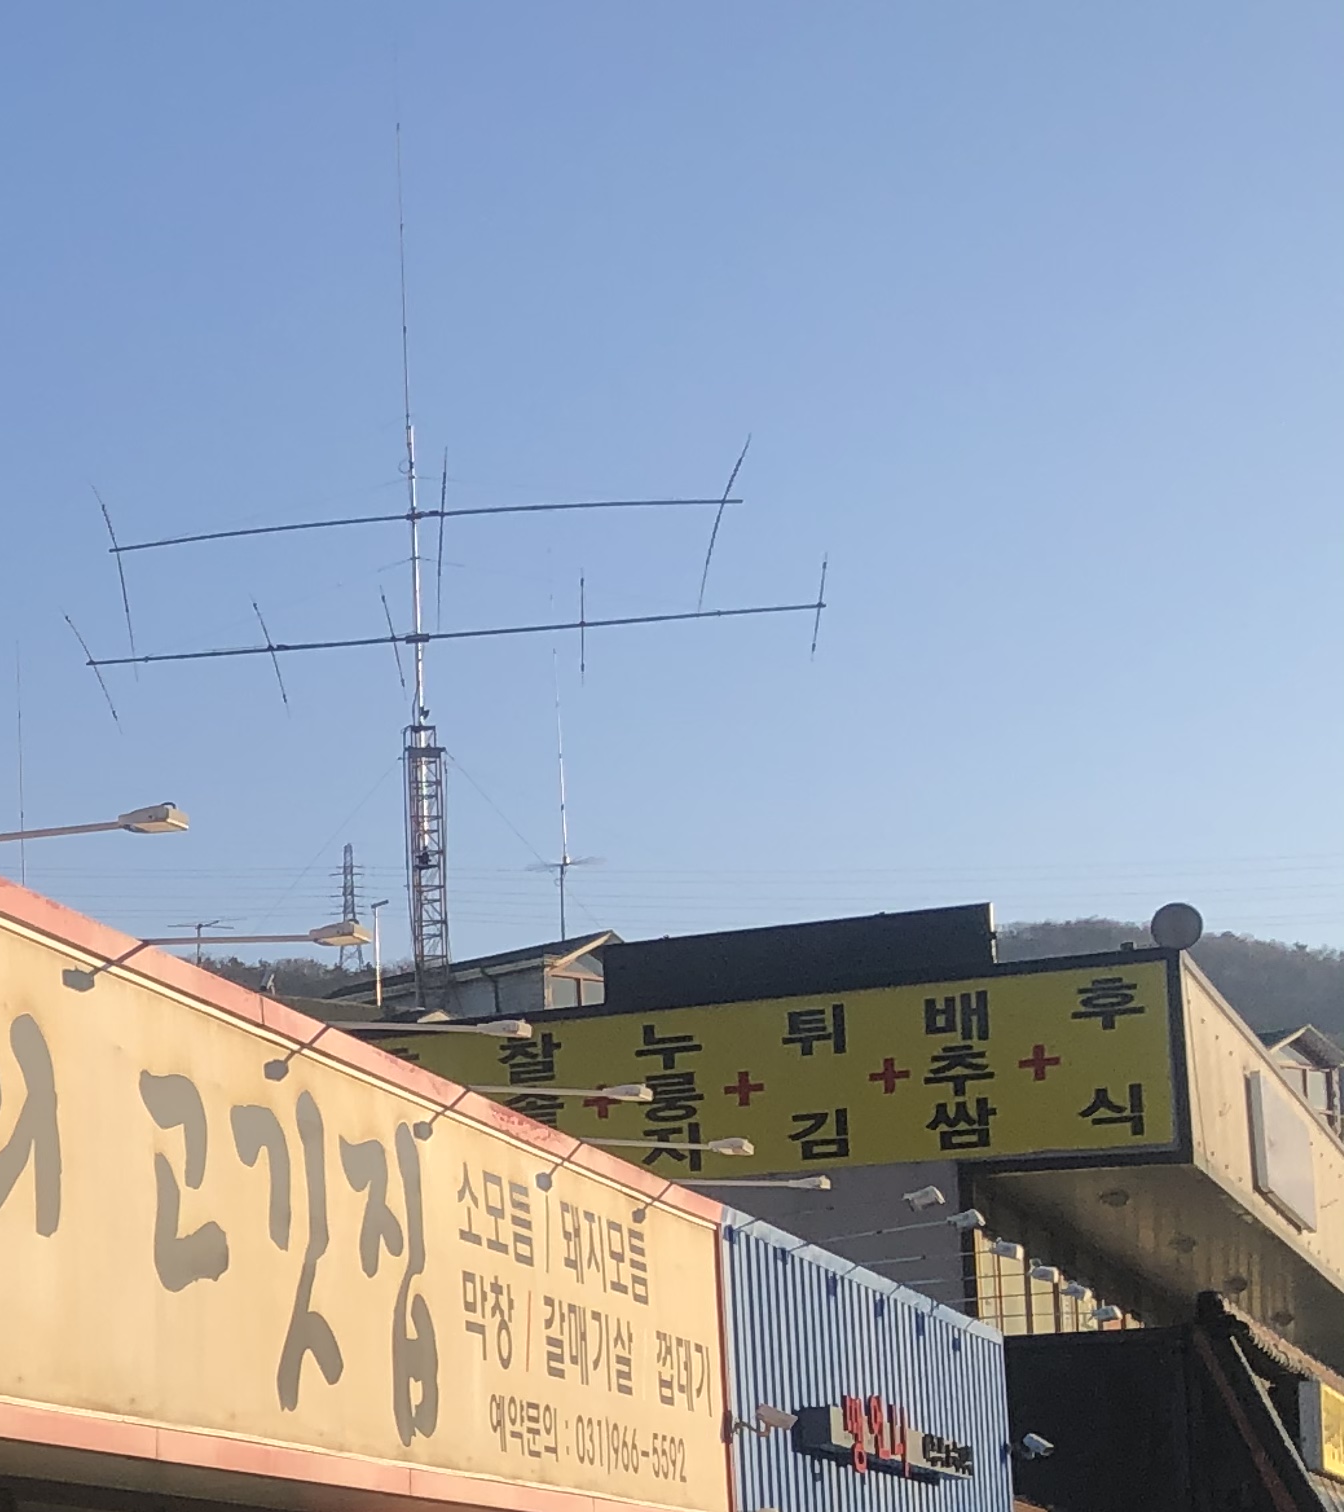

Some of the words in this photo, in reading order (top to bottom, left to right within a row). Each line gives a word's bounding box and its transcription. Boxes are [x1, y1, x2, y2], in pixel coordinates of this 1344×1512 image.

[635, 1024, 704, 1172] 누룽지
[782, 1003, 851, 1160] 튀김
[924, 990, 998, 1152] 배추쌈
[1072, 976, 1145, 1137] 후식
[139, 1069, 439, 1446] 고깃집
[457, 1162, 534, 1268] 소모듬
[560, 1200, 649, 1306] 돼지모듬
[462, 1270, 514, 1370] 막창
[543, 1295, 633, 1396] 갈매기살
[656, 1330, 712, 1418] 껍데기
[489, 1393, 559, 1462] 예약문의
